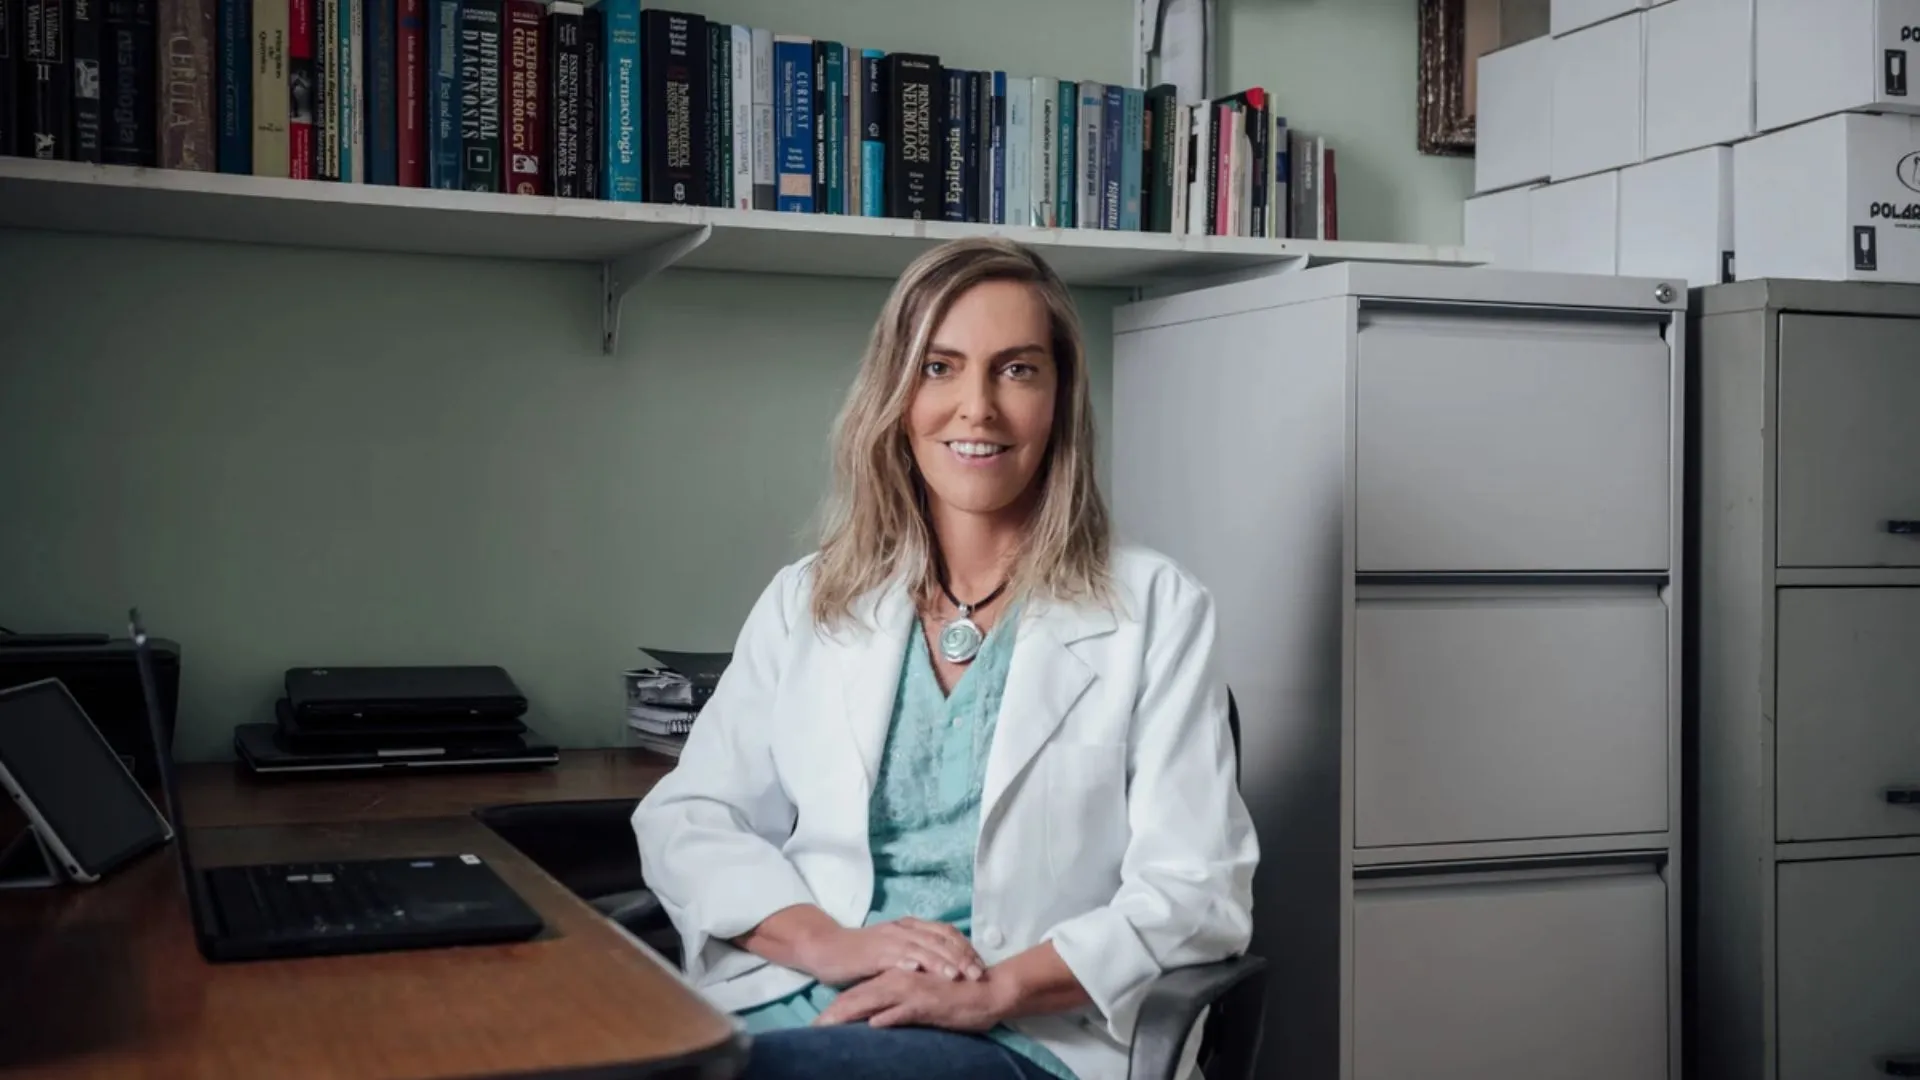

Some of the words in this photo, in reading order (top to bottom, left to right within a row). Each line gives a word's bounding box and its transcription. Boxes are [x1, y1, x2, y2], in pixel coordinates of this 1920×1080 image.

[512, 27, 525, 68] CHILD
[525, 29, 539, 99] TEXTBOOK
[559, 51, 569, 96] SCIENCE
[462, 29, 480, 139] DIAGNOSIS
[479, 31, 498, 141] DIFFERENTIAL
[512, 71, 525, 151] NEUROLOGY
[525, 101, 538, 119] OF
[559, 98, 569, 124] AND
[568, 53, 579, 114] ESSENTIALS
[617, 57, 635, 164] Farmacologia
[796, 71, 809, 130] CURRENT
[568, 115, 578, 129] OF
[679, 95, 691, 168] PHARMACOLOGICAL
[902, 82, 919, 163] NEUROLOGY
[918, 83, 931, 146] PRINCIPLES
[558, 125, 568, 177] BEHAVIOR
[567, 132, 578, 176] NEURAL
[918, 147, 930, 163] OF
[945, 127, 964, 205] Epilepsia
